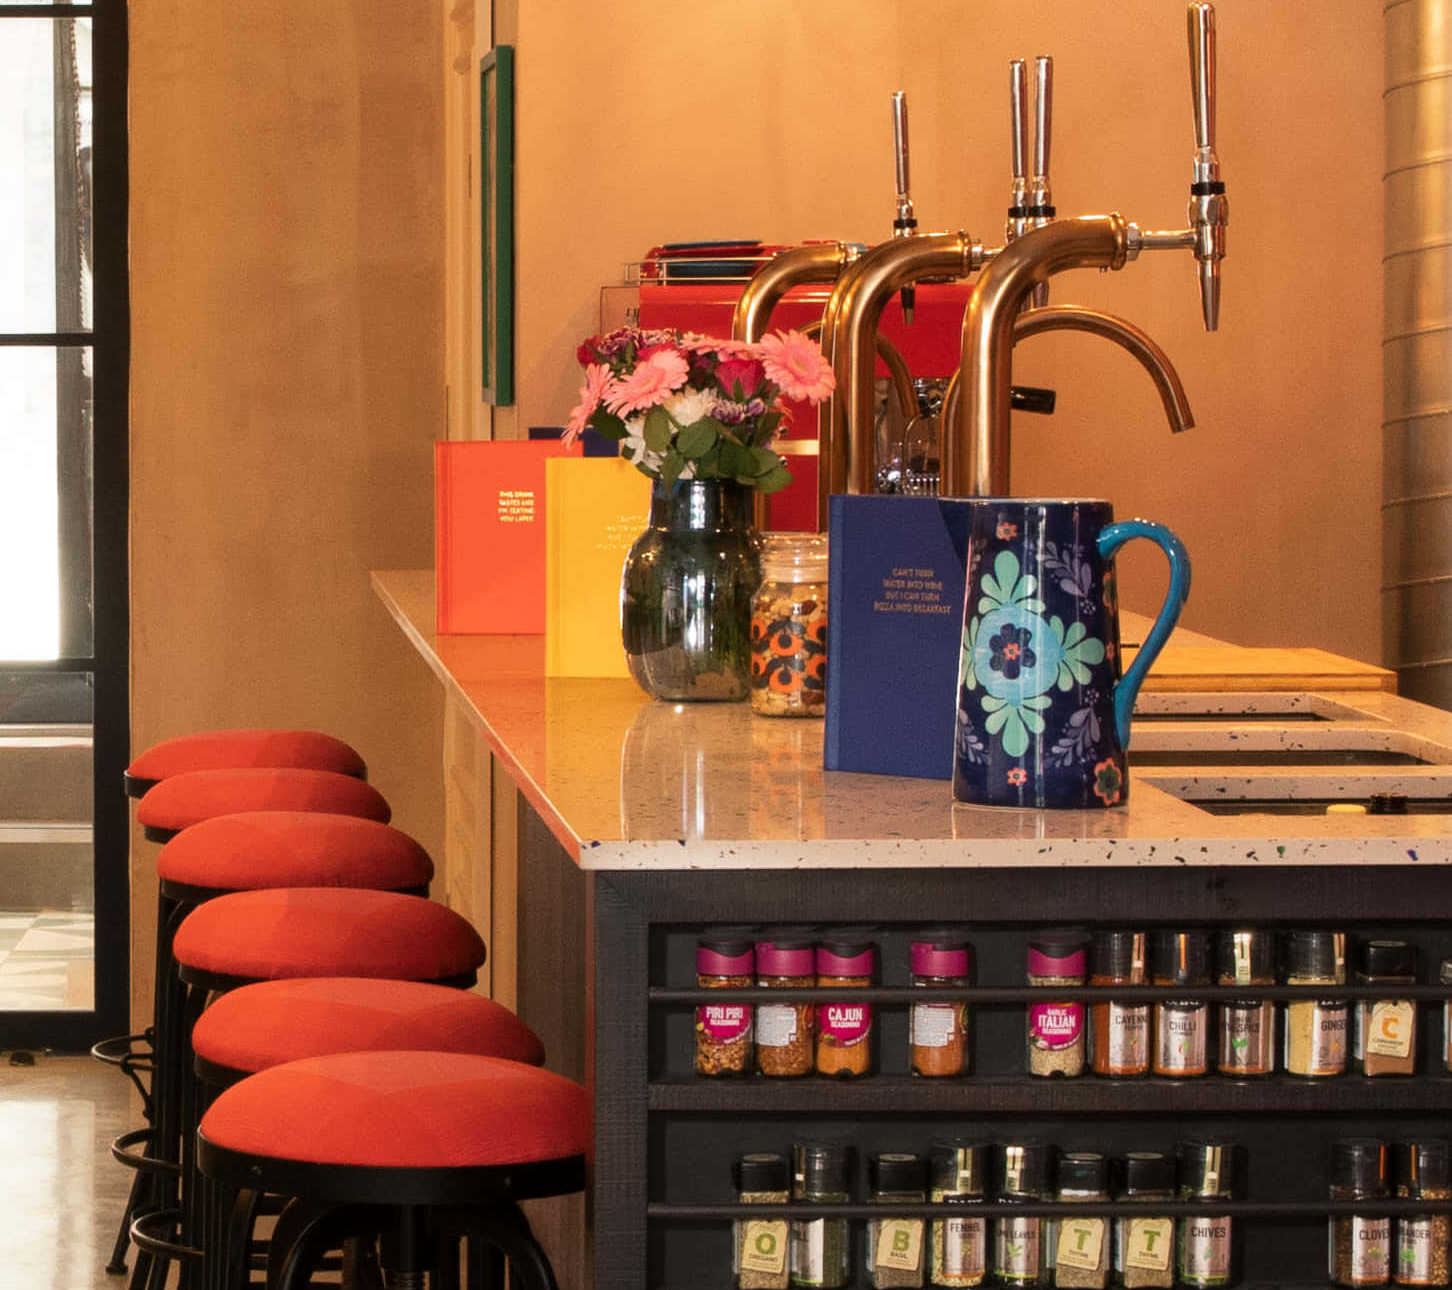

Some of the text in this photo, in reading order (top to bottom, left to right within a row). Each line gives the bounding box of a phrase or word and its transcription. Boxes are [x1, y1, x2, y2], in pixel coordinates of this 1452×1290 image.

[706, 1006, 744, 1019] PIRI PIRI
[828, 1007, 863, 1022] CAJUN
[1038, 1015, 1075, 1028] ITALIAN
[1169, 1021, 1197, 1031] CHILLI
[1381, 1017, 1399, 1039] C
[950, 1222, 980, 1233] FENNEL
[1191, 1227, 1226, 1238] CHIVES
[755, 1233, 776, 1255] O
[893, 1230, 910, 1252] B
[1074, 1228, 1092, 1251] T
[1143, 1230, 1161, 1251] T
